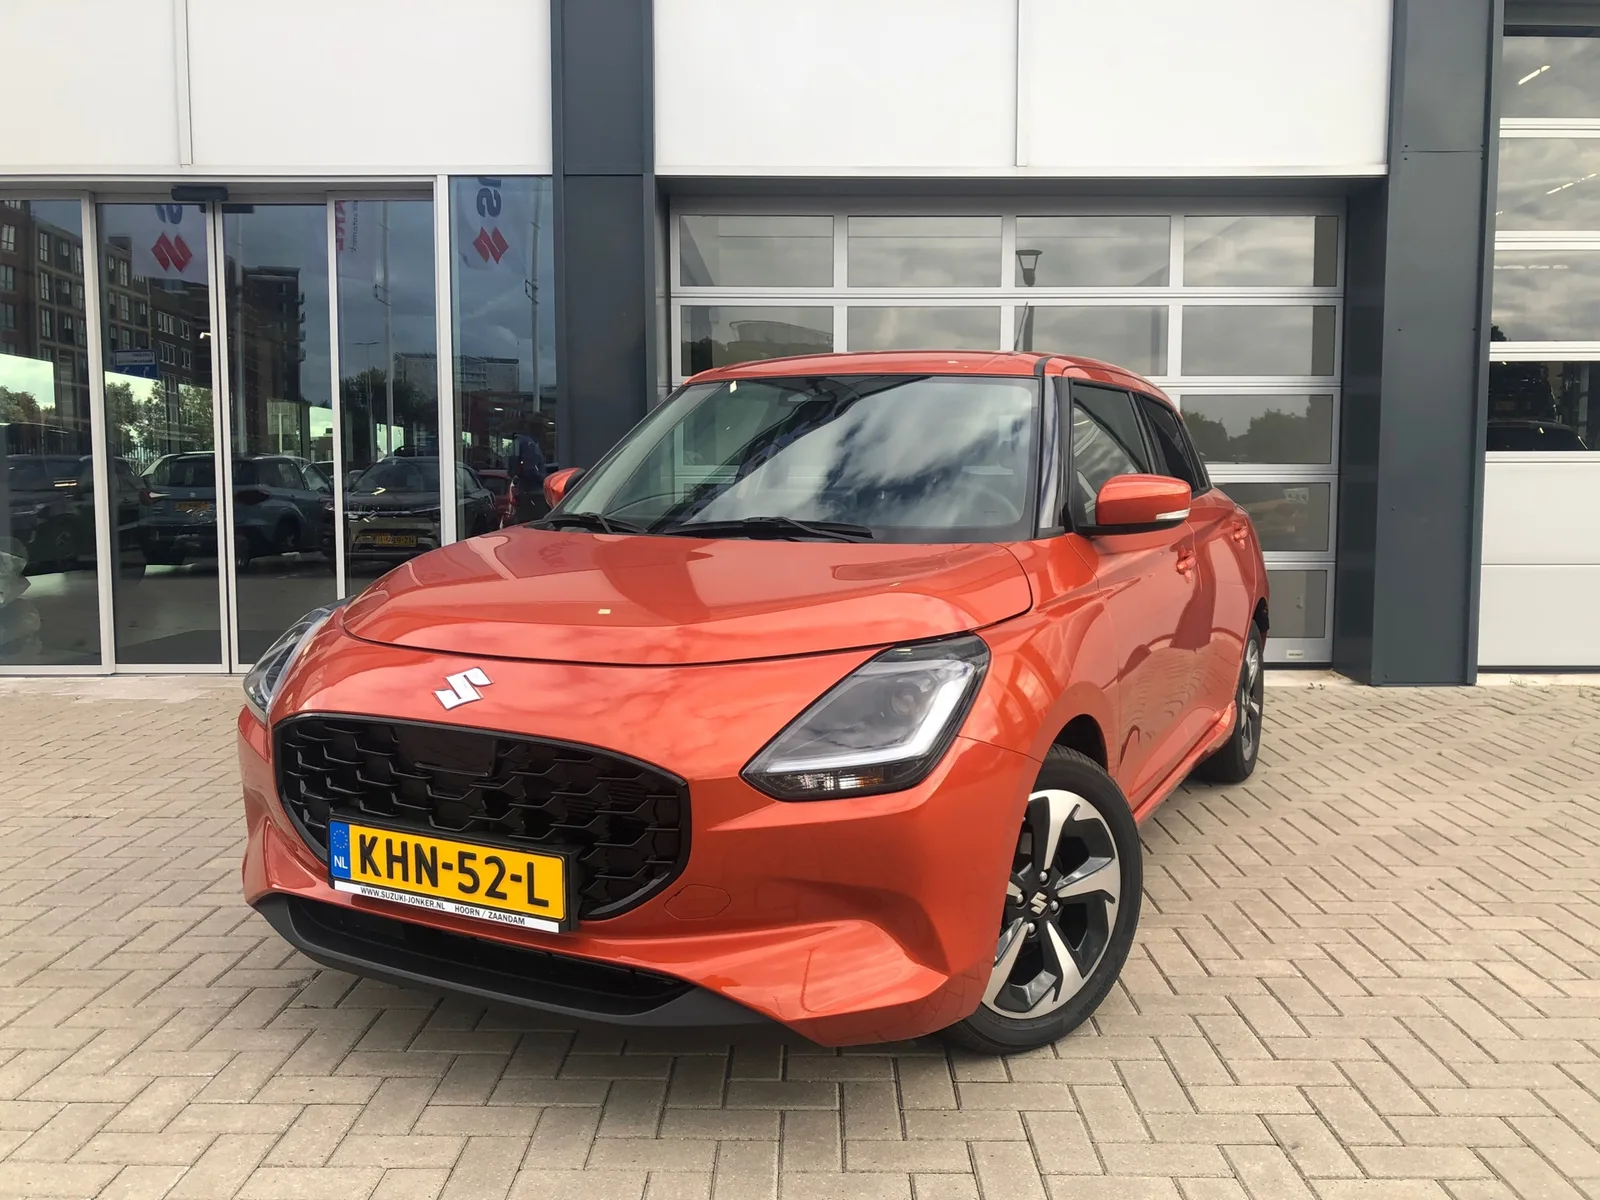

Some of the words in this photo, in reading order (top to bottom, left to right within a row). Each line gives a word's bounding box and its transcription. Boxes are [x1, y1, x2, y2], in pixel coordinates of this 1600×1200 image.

[334, 855, 348, 869] NL
[359, 834, 549, 907] KHN-52-L
[360, 887, 445, 910] WWW.SUZUKI-JONKER.NL
[455, 905, 480, 916] HOORN
[488, 912, 525, 925] ZAANDAM
